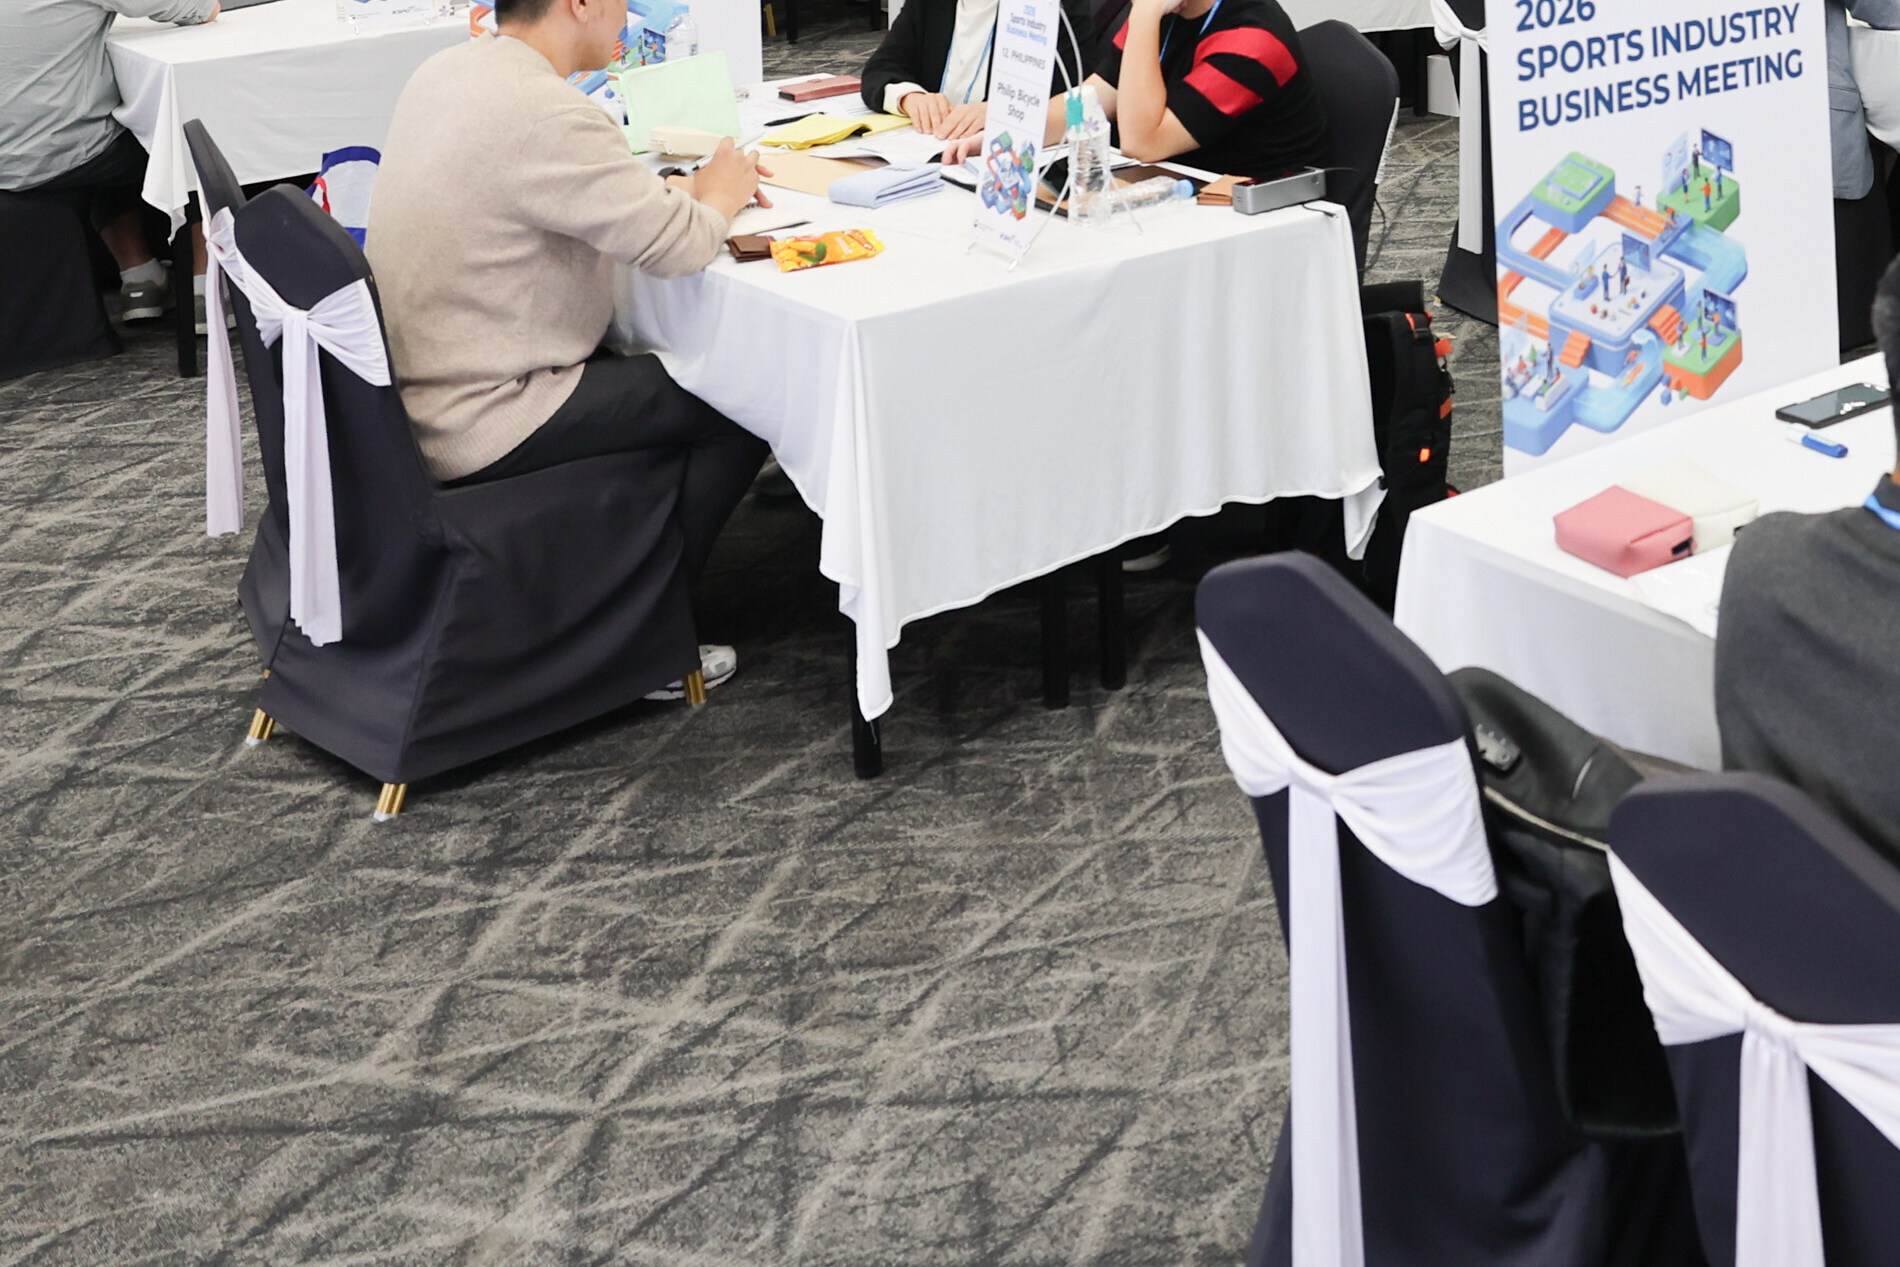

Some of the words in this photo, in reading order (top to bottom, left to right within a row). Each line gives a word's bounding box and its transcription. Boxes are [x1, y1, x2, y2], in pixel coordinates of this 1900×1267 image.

[1011, 49, 1046, 70] PHILIPPINES
[1517, 29, 1644, 82] SPORTS
[1652, 2, 1801, 58] INDUSTRY
[1007, 104, 1025, 123] Shop
[1518, 74, 1670, 132] BUSINESS
[1678, 49, 1803, 100] MEETING
